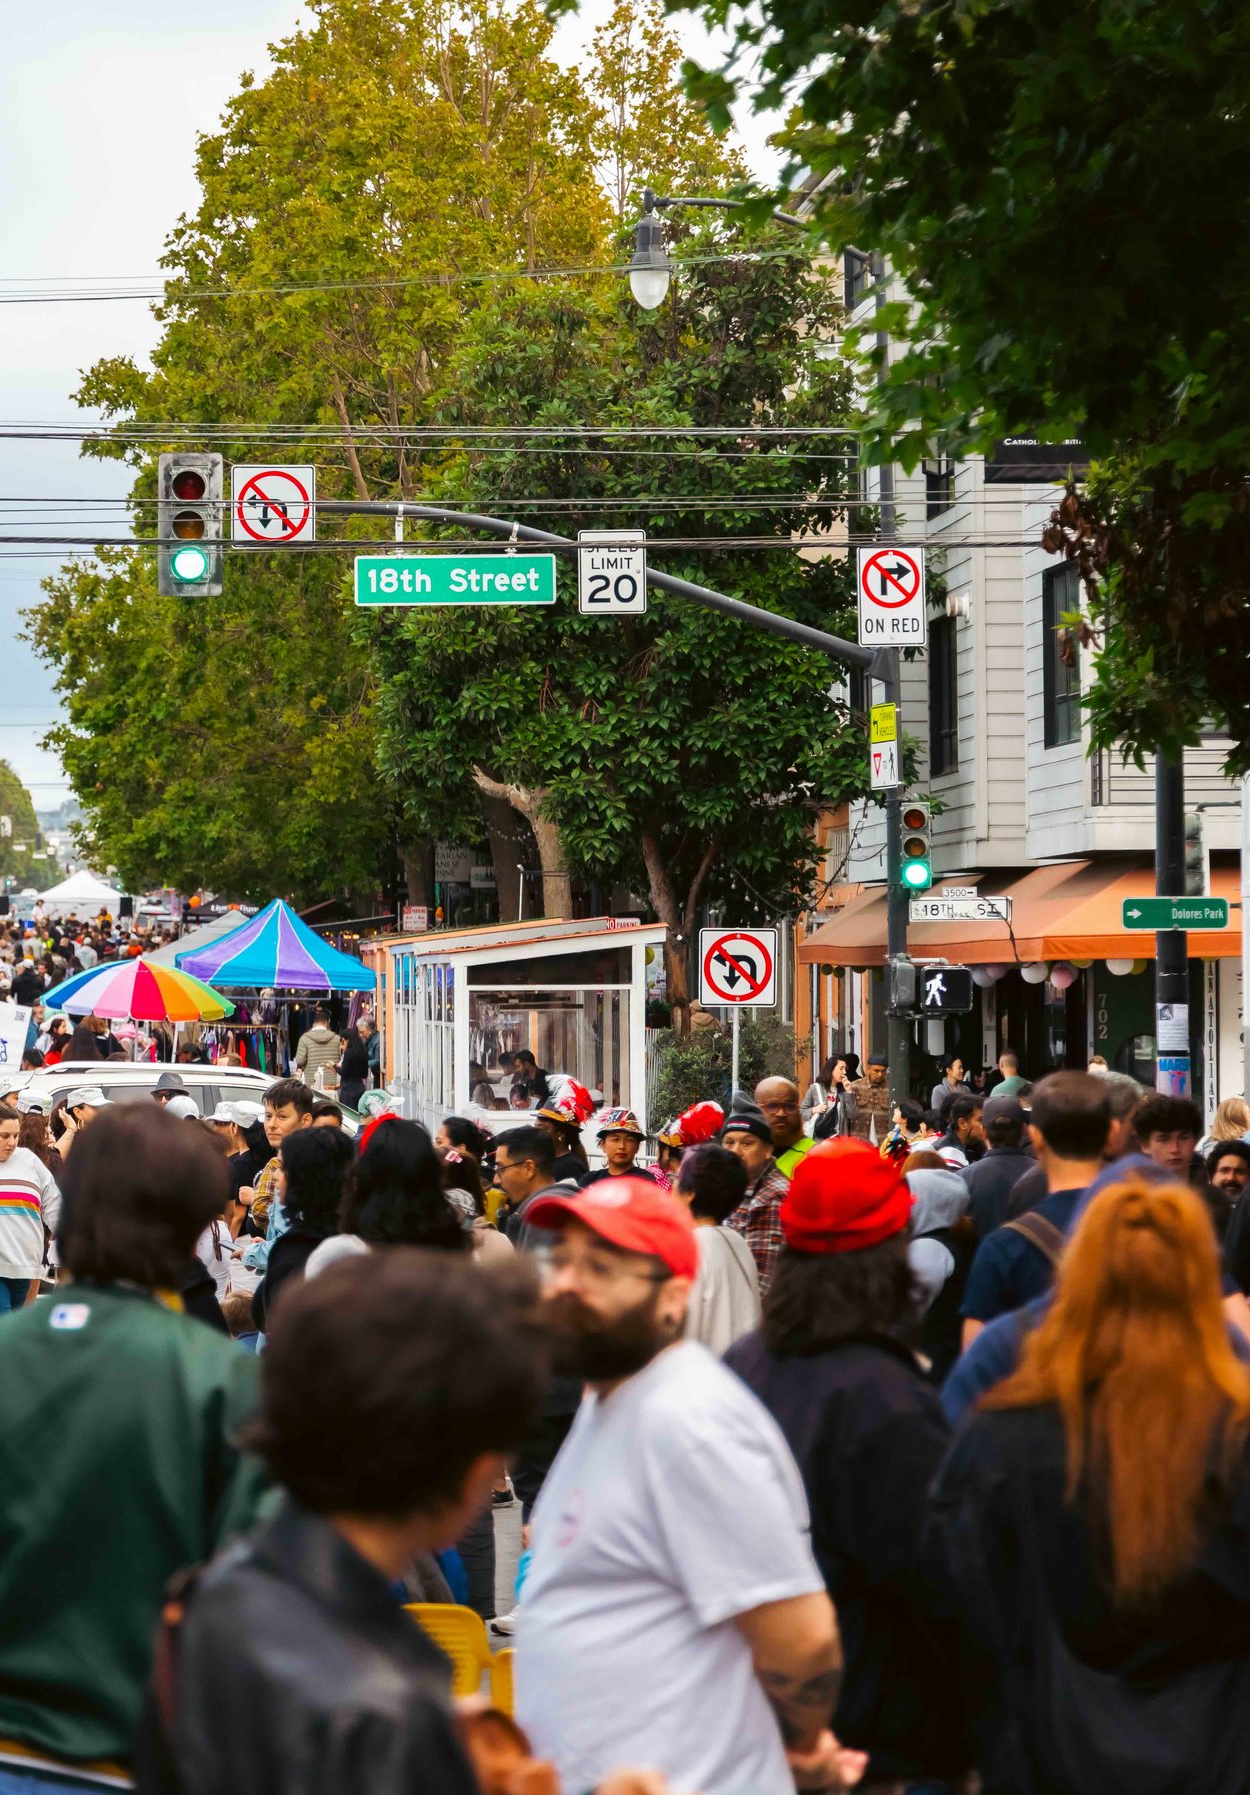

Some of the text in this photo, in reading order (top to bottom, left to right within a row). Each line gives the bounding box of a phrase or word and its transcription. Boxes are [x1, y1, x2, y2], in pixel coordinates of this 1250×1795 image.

[1004, 438, 1040, 446] CATHOL
[591, 557, 633, 570] LIMIT
[368, 567, 540, 593] 18th Street
[588, 574, 638, 604] 20
[865, 617, 920, 633] ON RED
[945, 888, 967, 898] 3500
[924, 903, 954, 916] 18TH
[1171, 908, 1224, 919] Dolores Park
[606, 918, 639, 930] NO PARKING
[1098, 994, 1108, 1039] 702
